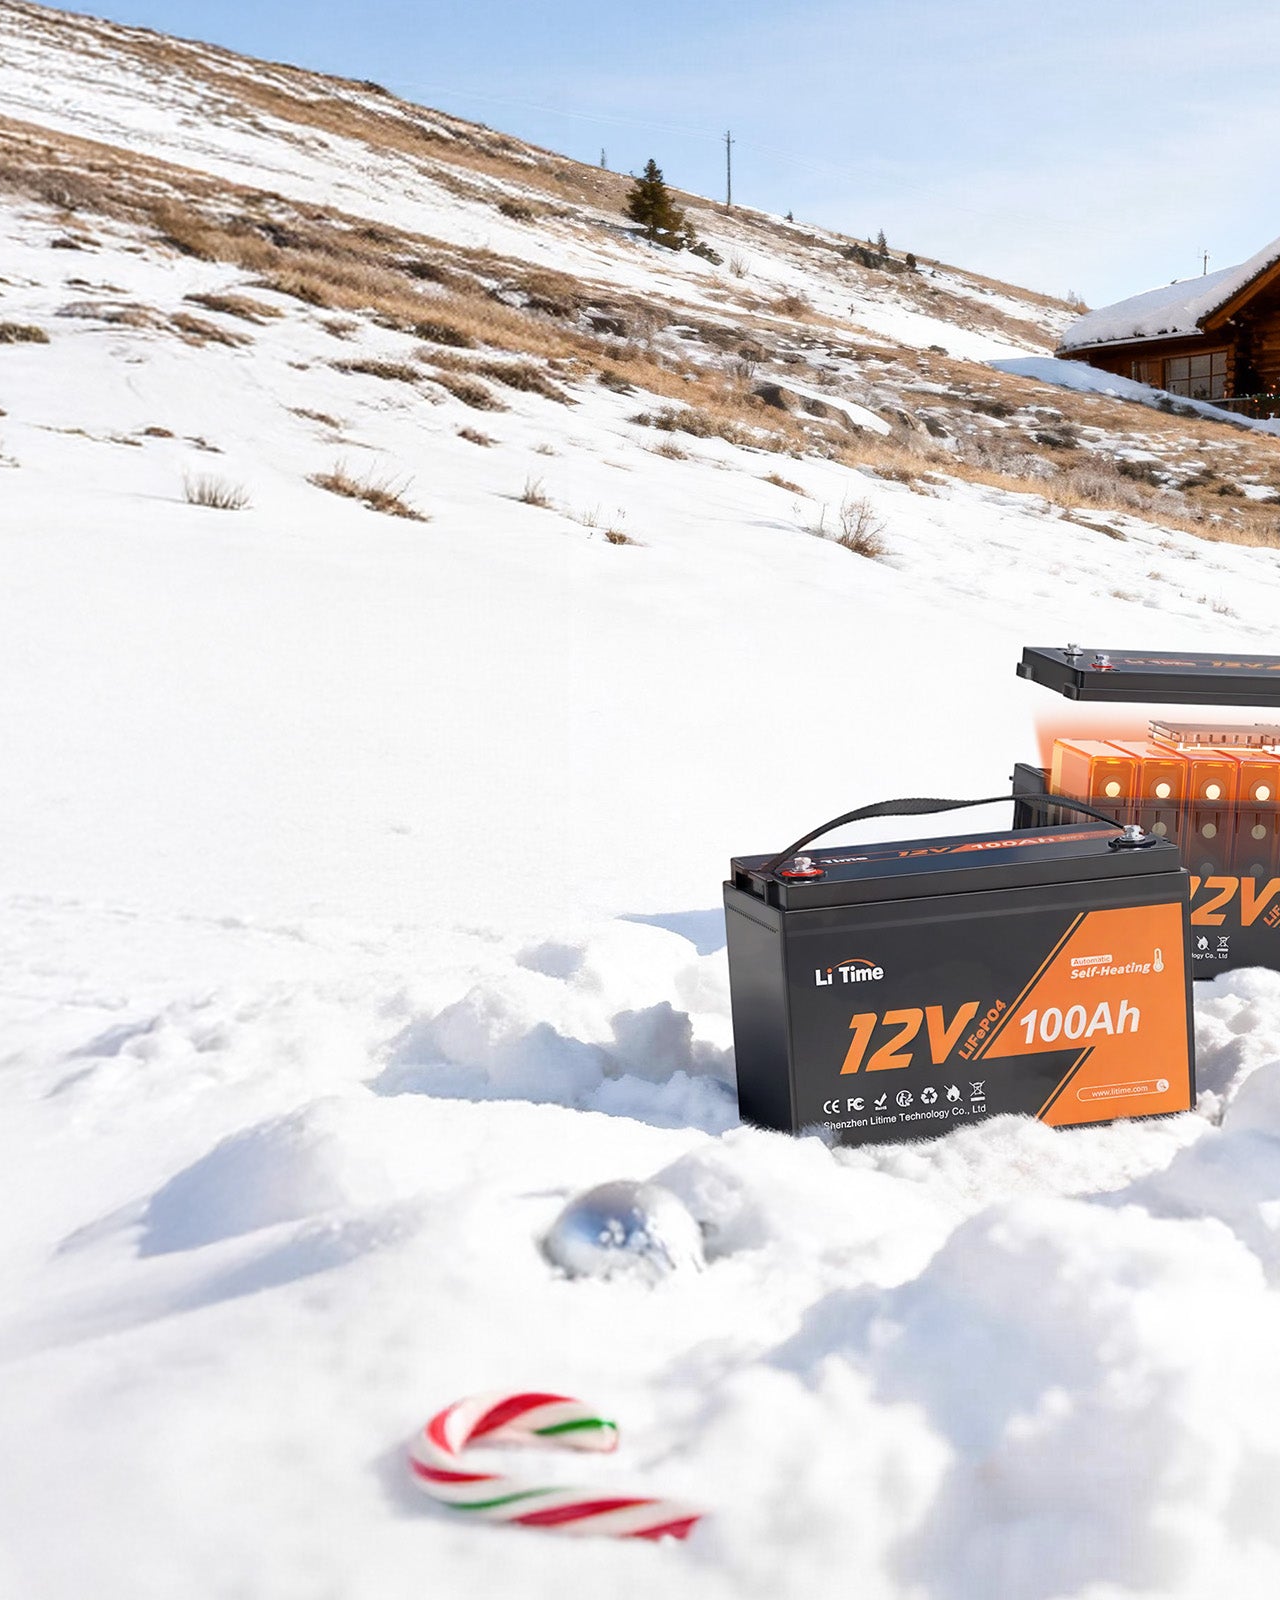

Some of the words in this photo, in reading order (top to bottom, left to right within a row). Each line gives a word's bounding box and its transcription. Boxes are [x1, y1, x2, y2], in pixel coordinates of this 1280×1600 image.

[898, 846, 952, 858] 12V
[971, 835, 1055, 850] 100Ah
[1070, 962, 1152, 980] Self-Heating
[1073, 955, 1110, 966] Automatic
[815, 967, 833, 987] Li
[838, 964, 885, 983] Time
[958, 999, 1007, 1061] LiFePO4
[1019, 999, 1142, 1045] 100Ah
[840, 1001, 981, 1075] 12V
[1091, 1085, 1149, 1098] www.litime.com
[824, 1118, 868, 1130] Shenzhen
[870, 1114, 897, 1126] Litime
[899, 1109, 950, 1122] Technology
[951, 1106, 970, 1116] Co.,
[972, 1104, 987, 1114] Ltd
